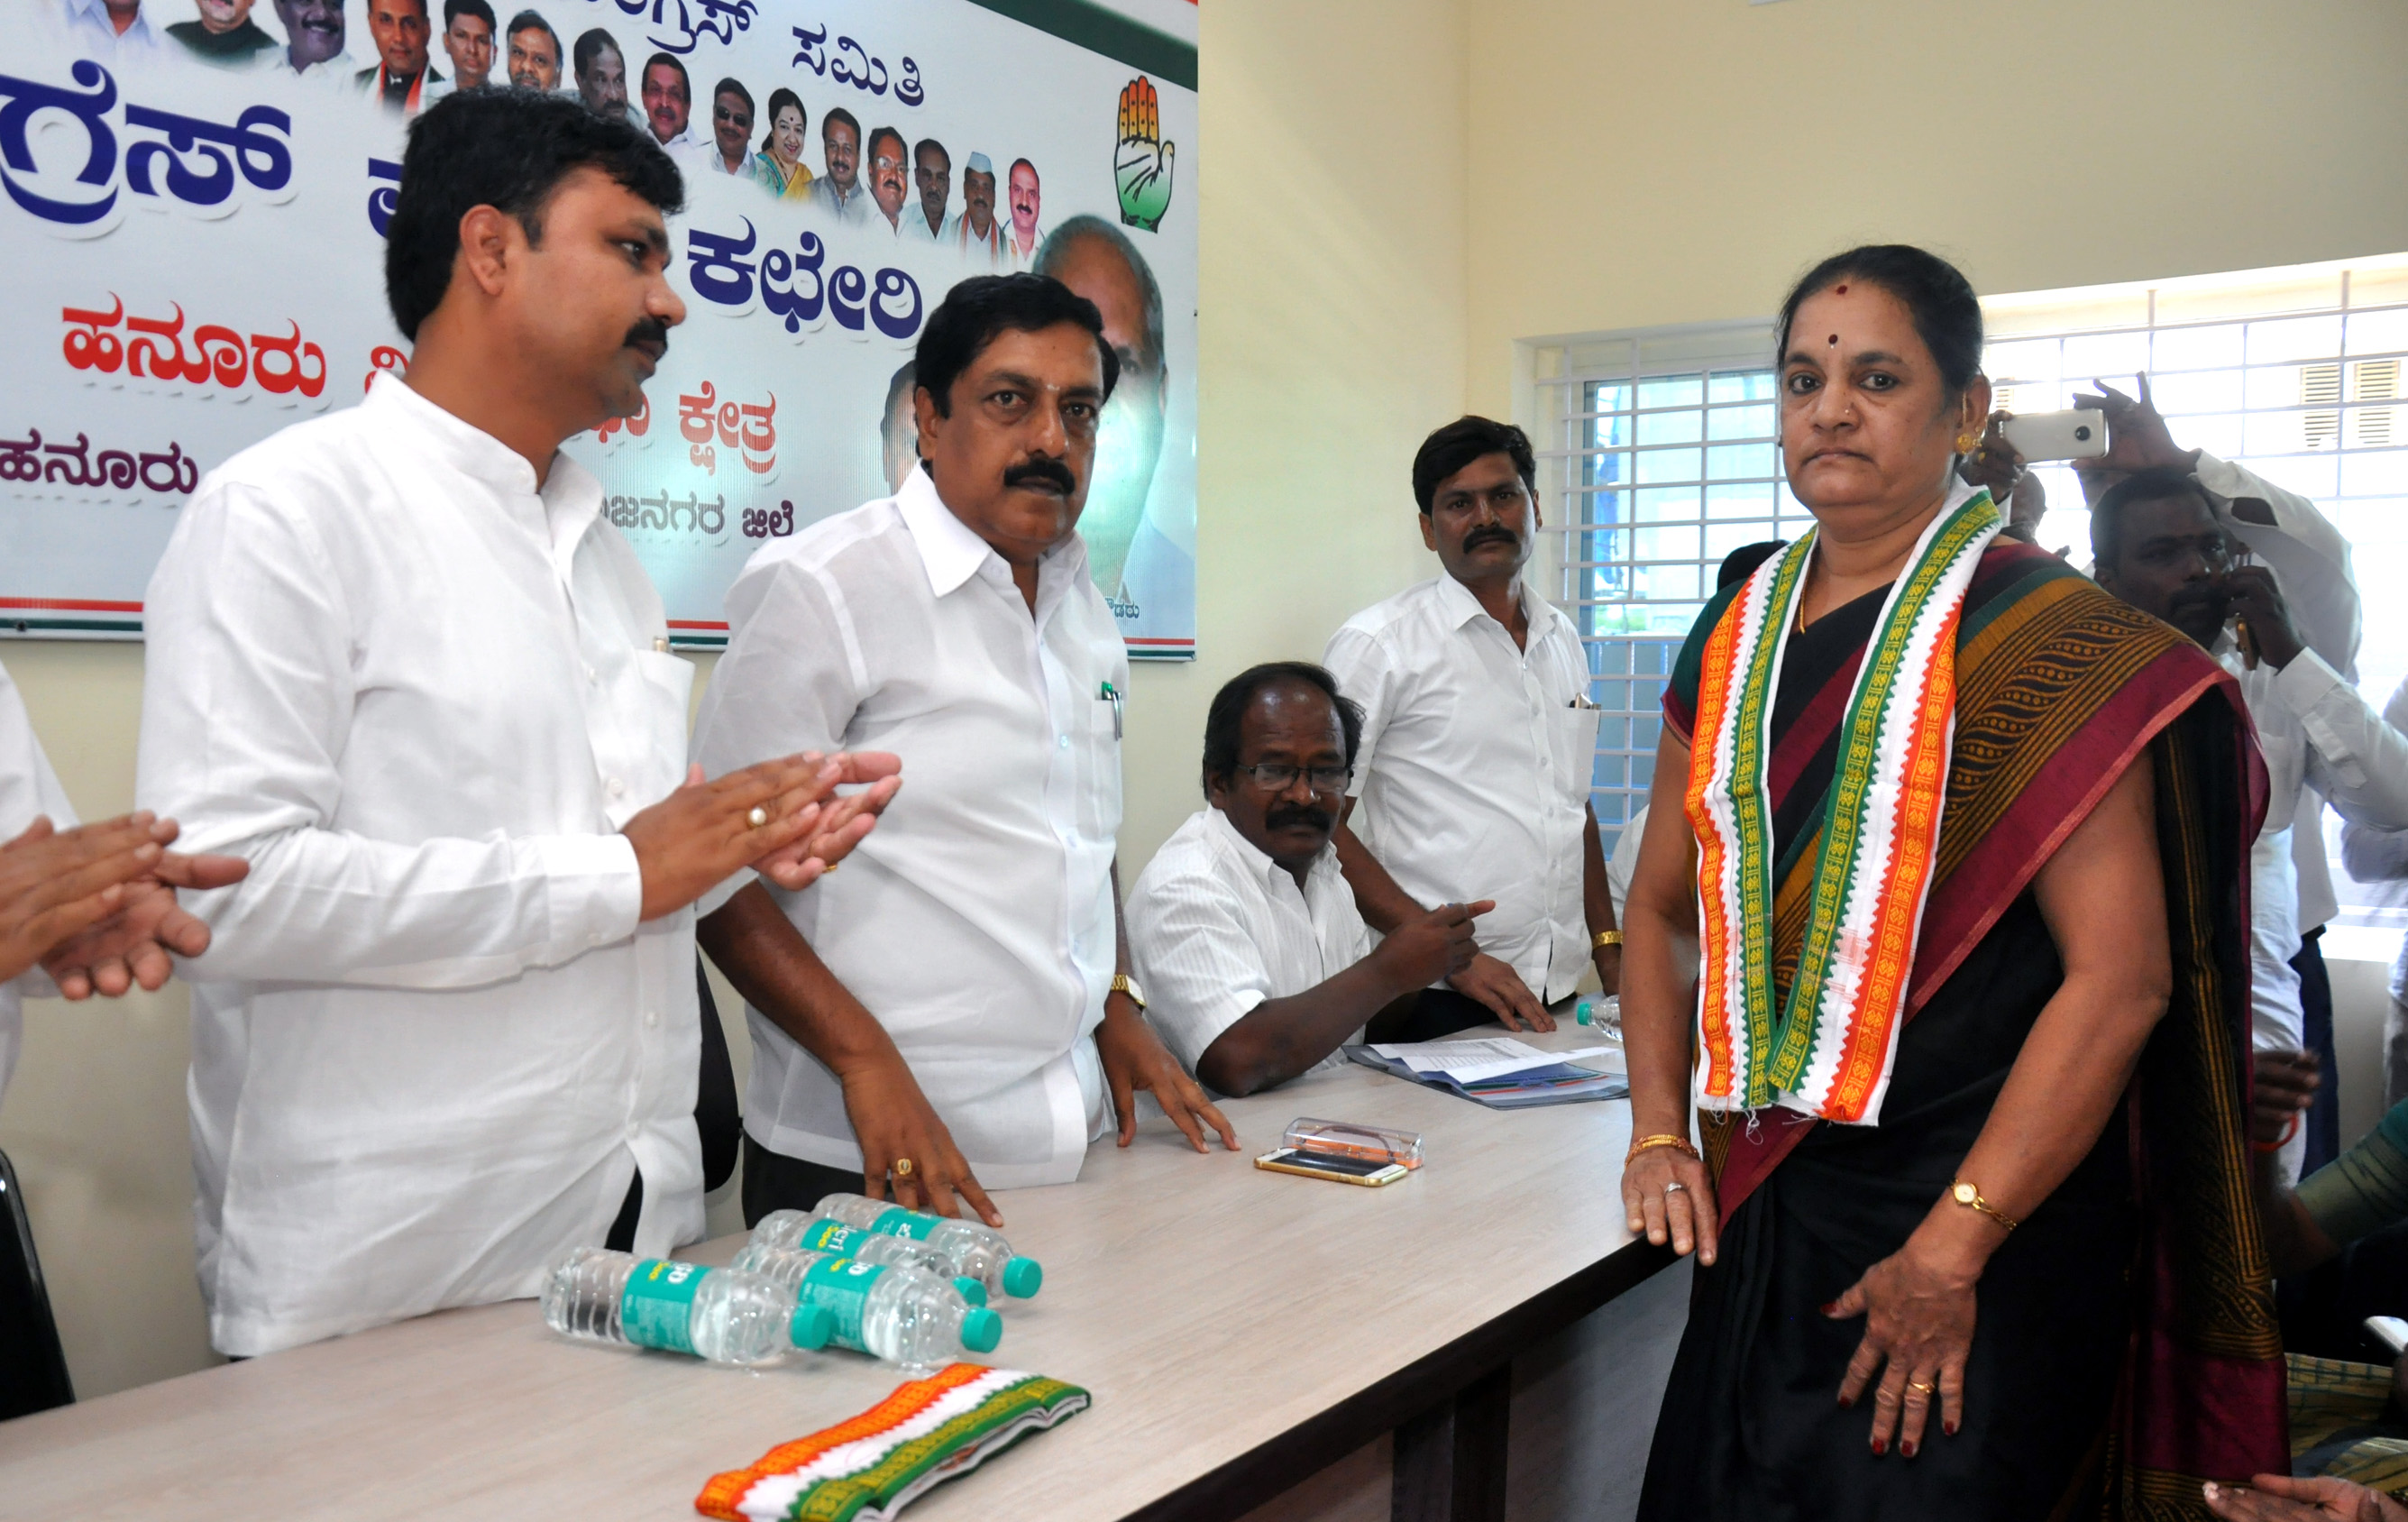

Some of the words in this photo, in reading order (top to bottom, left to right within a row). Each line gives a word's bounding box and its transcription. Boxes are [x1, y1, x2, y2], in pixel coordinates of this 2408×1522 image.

[792, 23, 925, 106] ಸಮಿತಿ
[686, 215, 922, 340] ಕಛೇರಿ
[62, 290, 326, 399] ಹನೂರು
[678, 380, 777, 476] ಕ್ಷೇತ್ರ
[0, 427, 198, 494] ಹನೂರು
